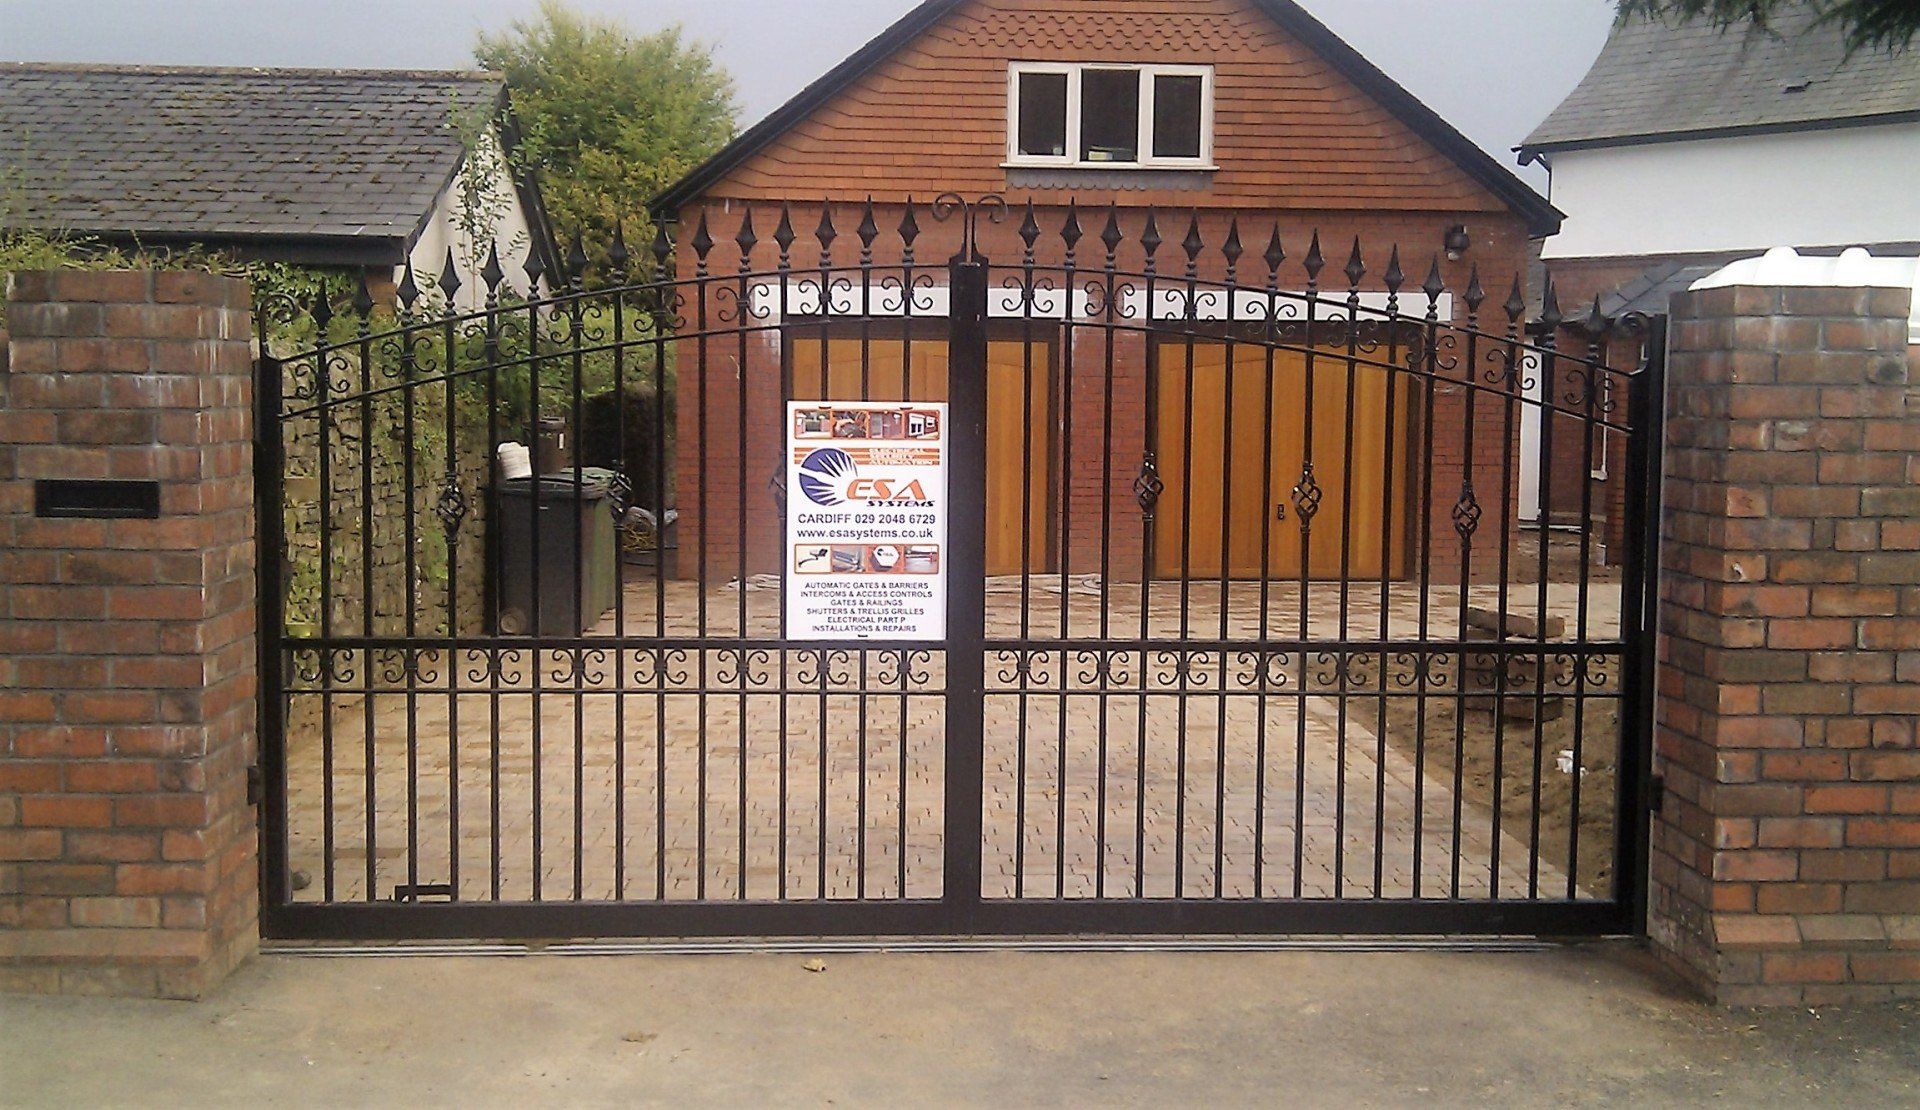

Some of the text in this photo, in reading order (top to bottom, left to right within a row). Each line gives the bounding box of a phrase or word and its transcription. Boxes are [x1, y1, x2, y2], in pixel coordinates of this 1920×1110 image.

[846, 478, 926, 500] ESA
[798, 514, 936, 524] CARDIFF 029 2048 6729
[797, 528, 933, 540] www.esasystems.co.uk
